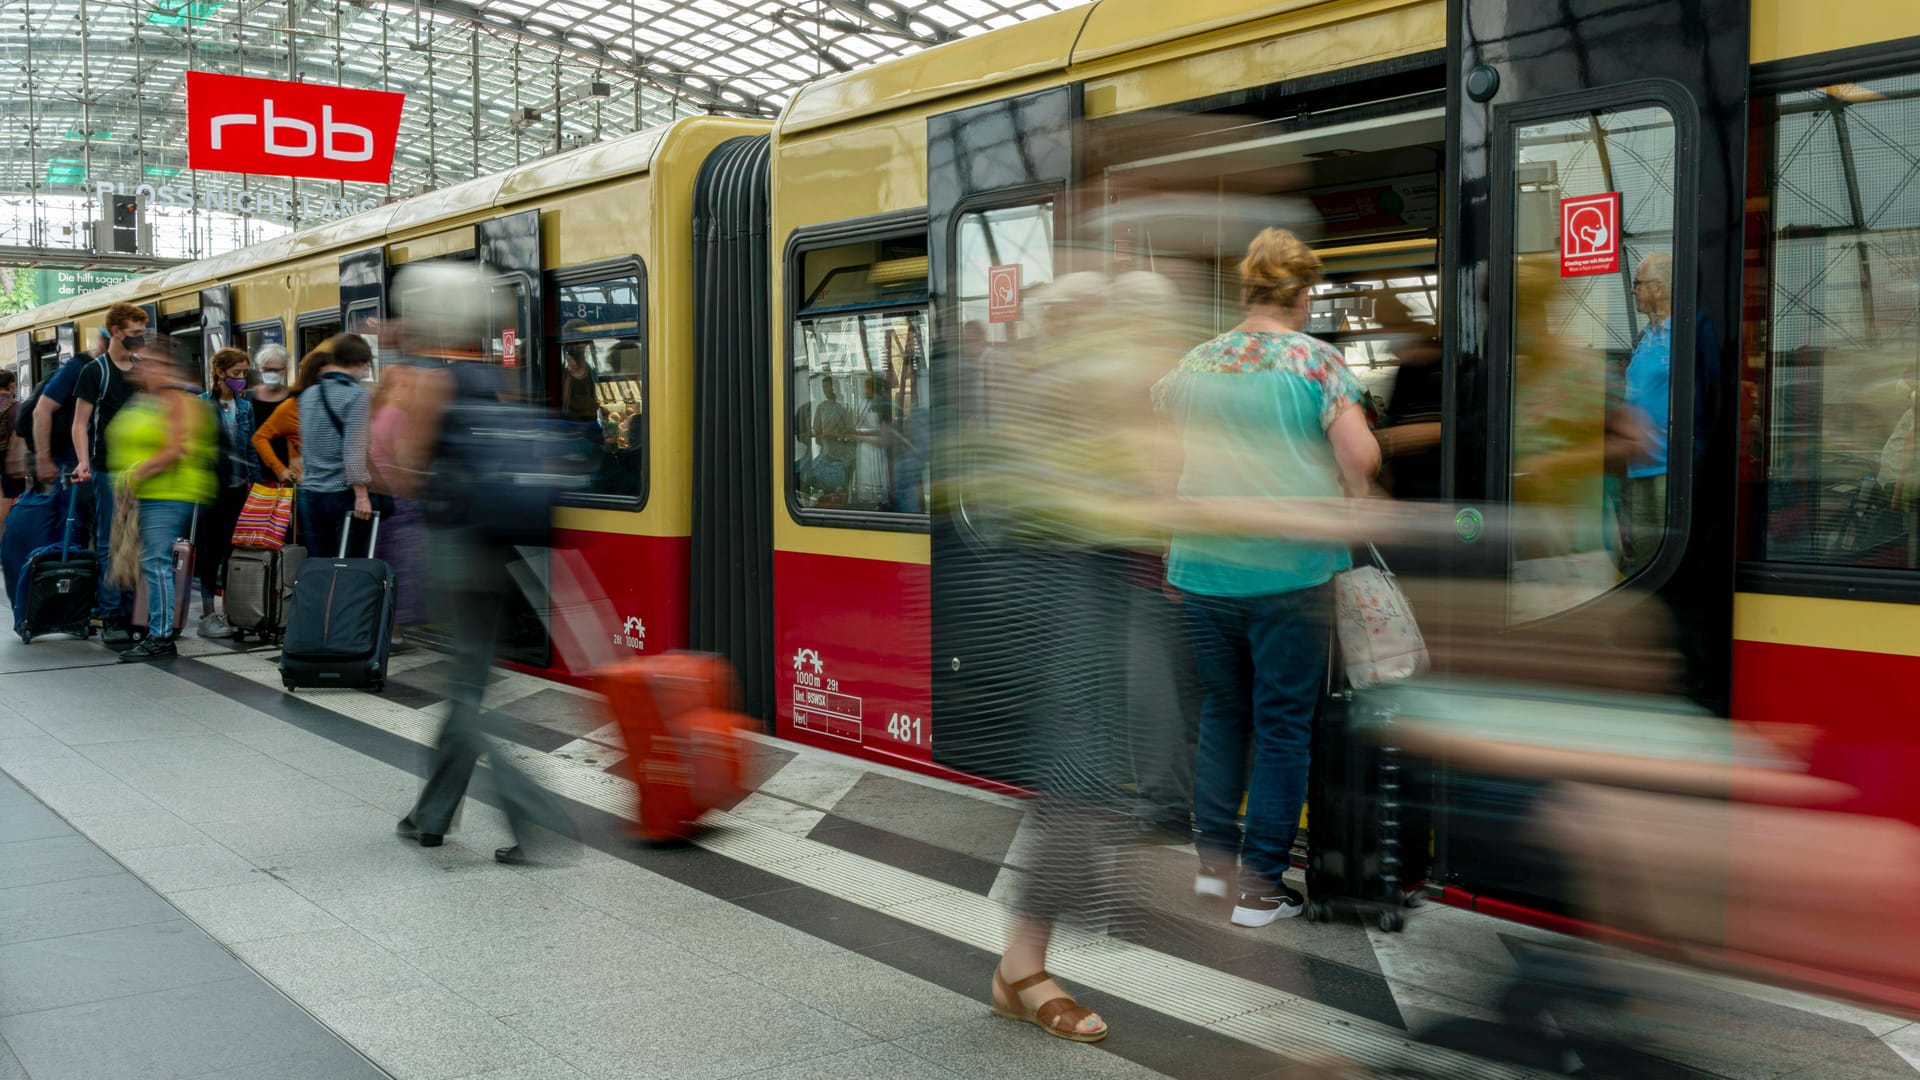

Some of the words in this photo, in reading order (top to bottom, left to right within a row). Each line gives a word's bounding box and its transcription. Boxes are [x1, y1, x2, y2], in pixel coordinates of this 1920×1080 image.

[211, 98, 374, 162] rbb
[205, 190, 292, 216] NICHT
[58, 272, 74, 282] Die
[77, 272, 93, 283] hilft
[95, 276, 123, 287] sogar
[58, 284, 75, 294] der
[826, 678, 839, 692] 29t
[887, 712, 921, 745] 481
